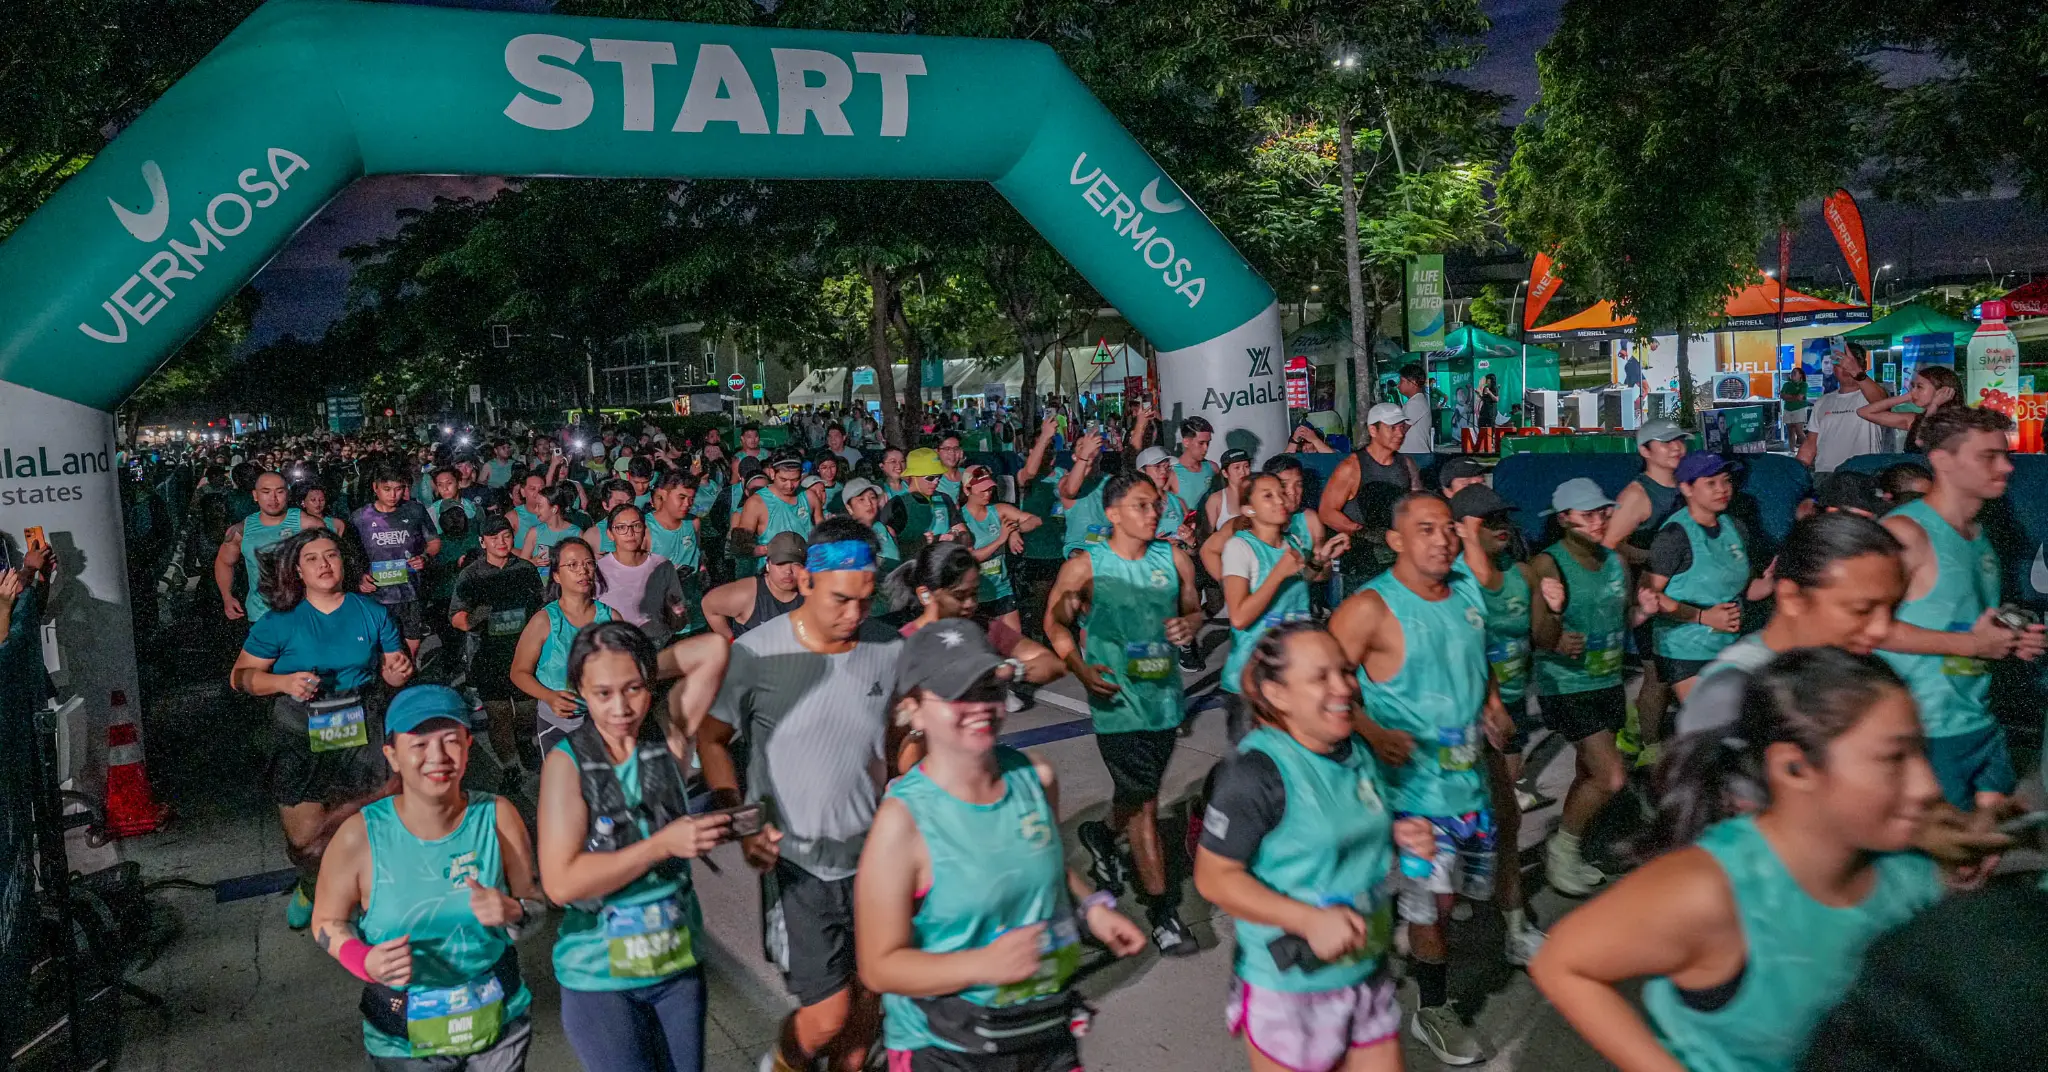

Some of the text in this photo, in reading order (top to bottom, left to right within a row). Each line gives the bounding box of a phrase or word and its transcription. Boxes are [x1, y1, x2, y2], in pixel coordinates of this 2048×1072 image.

[503, 33, 927, 137] START
[1069, 151, 1207, 309] VERMOSA
[1828, 203, 1863, 269] MERRELL
[78, 146, 310, 344] VERMOSA
[1412, 270, 1439, 282] A LIFE
[1416, 284, 1438, 295] WELL
[1409, 297, 1443, 309] PLAYED
[1979, 355, 2016, 365] SMART
[1994, 366, 2006, 376] C
[2018, 399, 2048, 421] Ois
[0, 444, 109, 480] laLand
[2, 484, 83, 505] states
[372, 530, 410, 540] ABERYA
[377, 537, 406, 546] CREW
[320, 724, 358, 741] 10433
